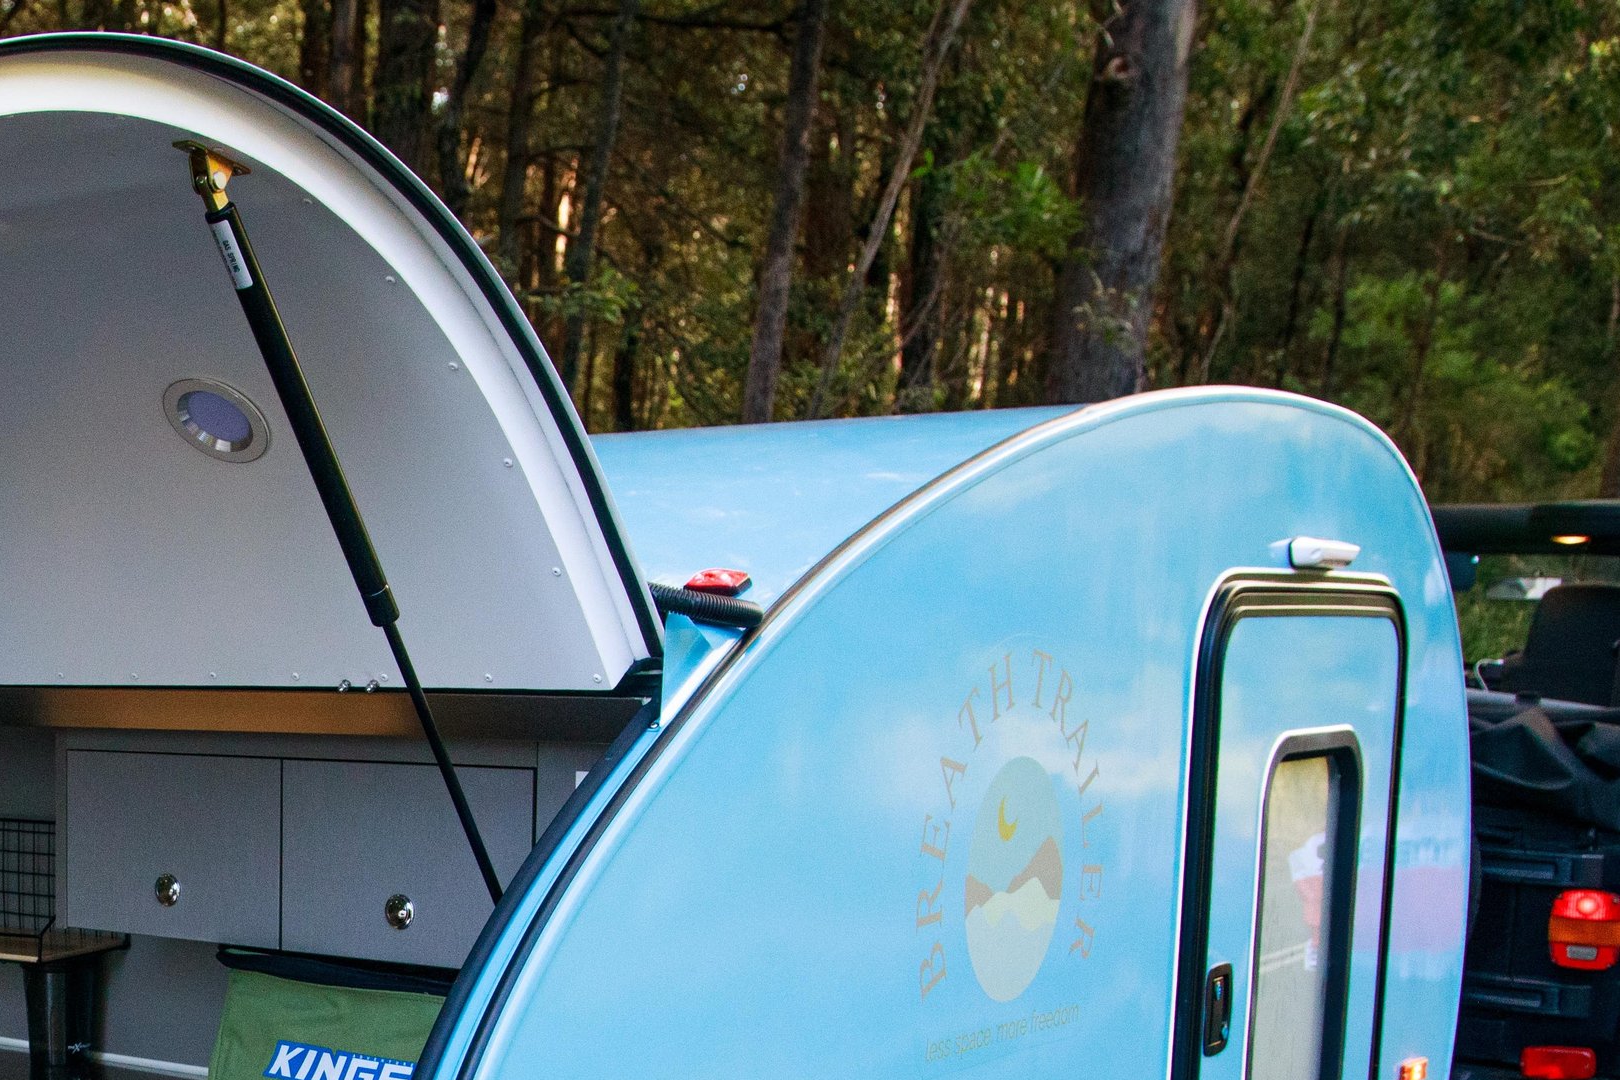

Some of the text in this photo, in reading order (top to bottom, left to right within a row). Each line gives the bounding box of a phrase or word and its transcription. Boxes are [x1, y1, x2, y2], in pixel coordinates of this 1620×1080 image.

[222, 240, 231, 251] GAS
[227, 252, 240, 273] SPRING
[925, 1004, 1080, 1062] less space more freedom
